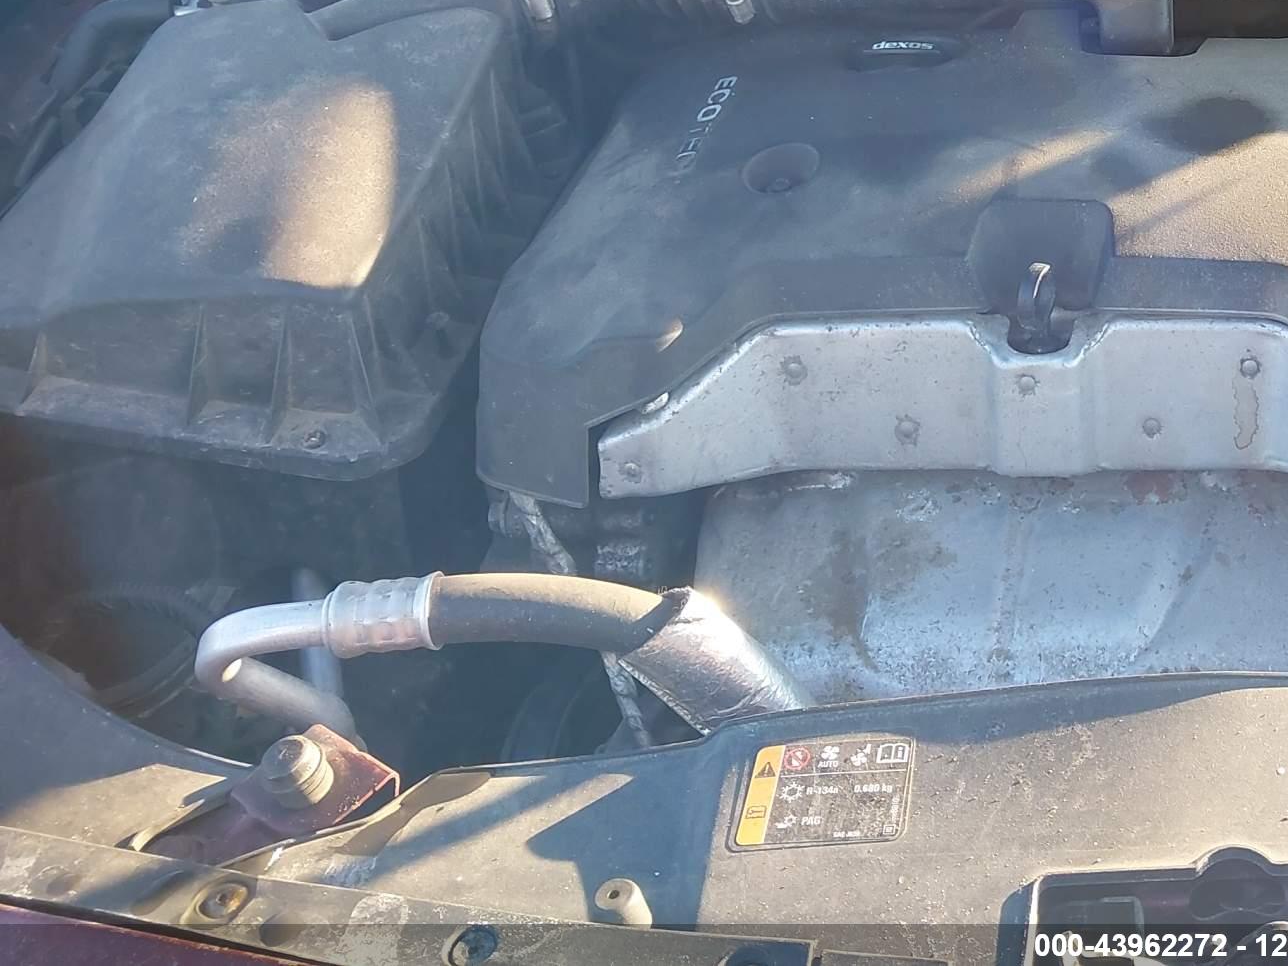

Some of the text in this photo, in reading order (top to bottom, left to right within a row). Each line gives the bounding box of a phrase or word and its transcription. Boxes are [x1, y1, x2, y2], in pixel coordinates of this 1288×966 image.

[872, 40, 935, 51] dexos
[817, 760, 839, 768] AUTO
[853, 784, 880, 793] 0.680
[881, 783, 893, 794] kg
[801, 816, 821, 825] PAG
